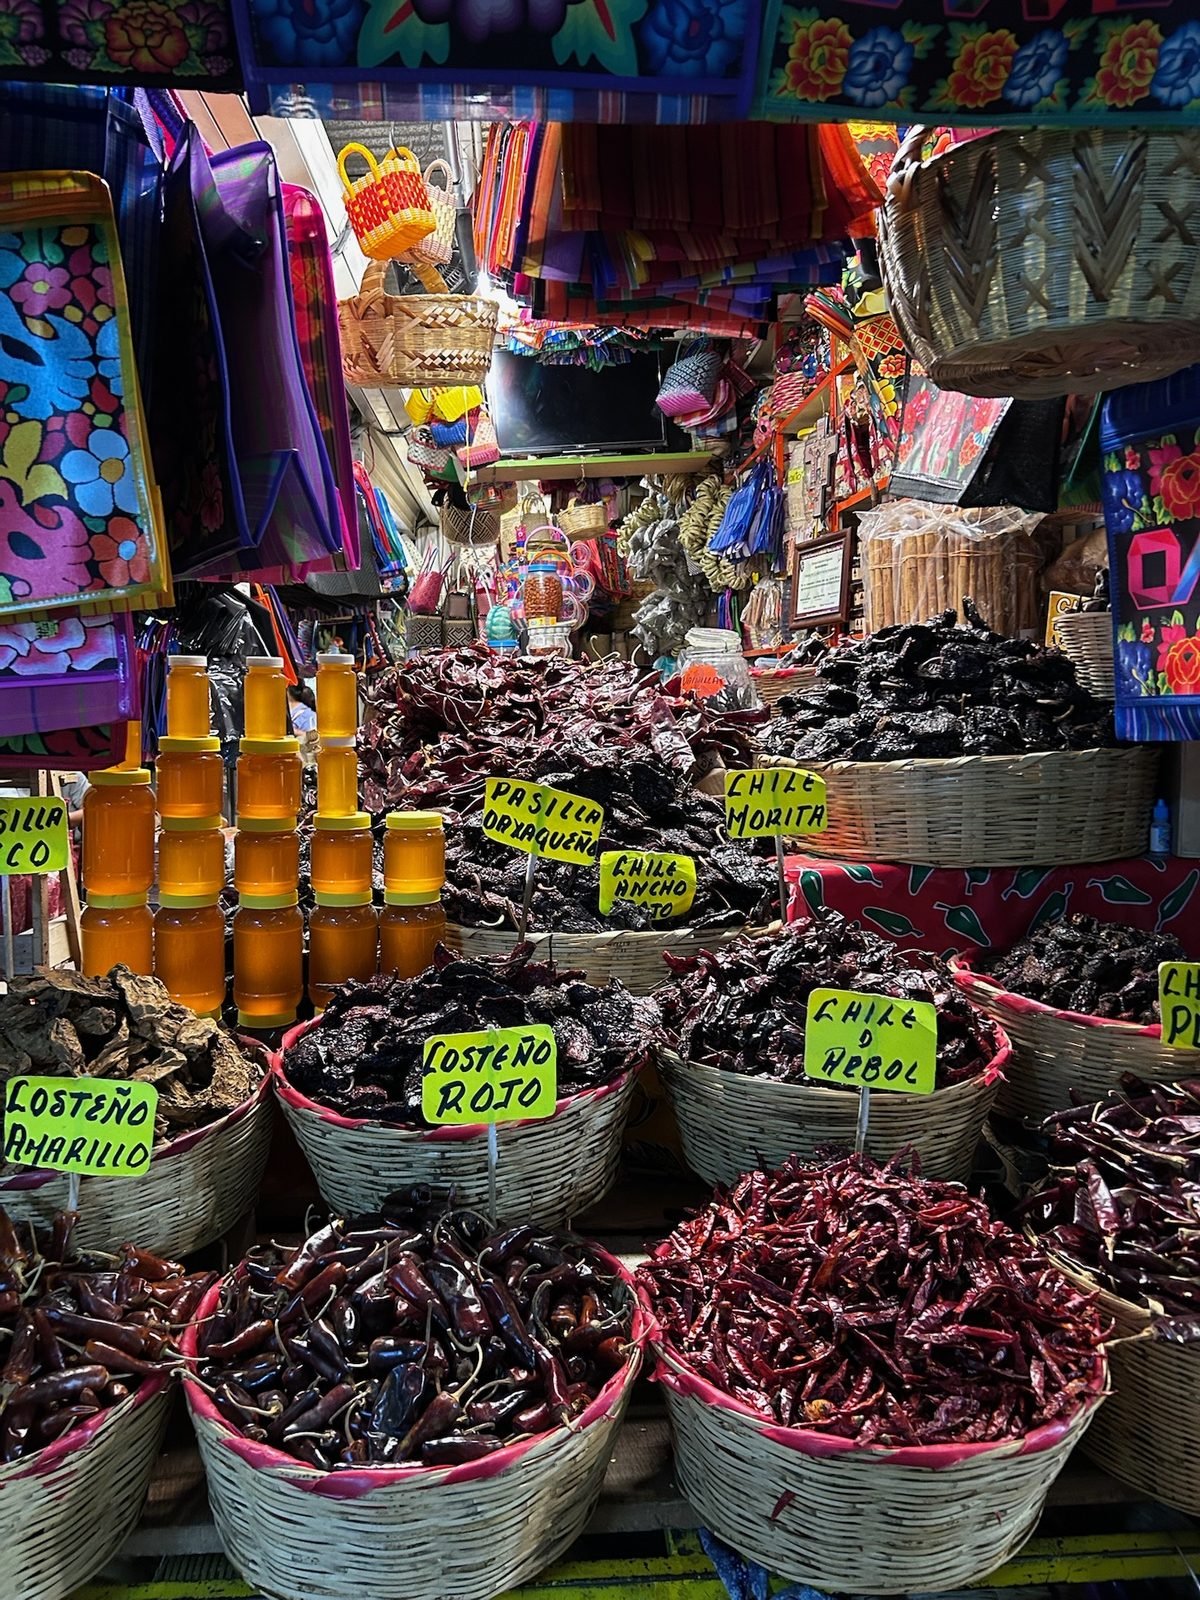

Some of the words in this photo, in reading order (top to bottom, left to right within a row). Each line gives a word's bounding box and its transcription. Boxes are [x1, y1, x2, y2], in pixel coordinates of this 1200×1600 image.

[727, 772, 815, 797] CHILE
[490, 781, 601, 825] PASILLA
[727, 804, 825, 837] MORITA
[612, 854, 677, 877] CHILE
[614, 879, 687, 897] ANCHO
[813, 998, 916, 1029] CHILE
[422, 1035, 552, 1077] COSTEÑO
[858, 1029, 873, 1048] D
[822, 1047, 918, 1084] ARBOL
[6, 1080, 148, 1126] COSTEÑO
[436, 1077, 542, 1118] ROJO
[5, 1123, 149, 1167] AMARILLO
